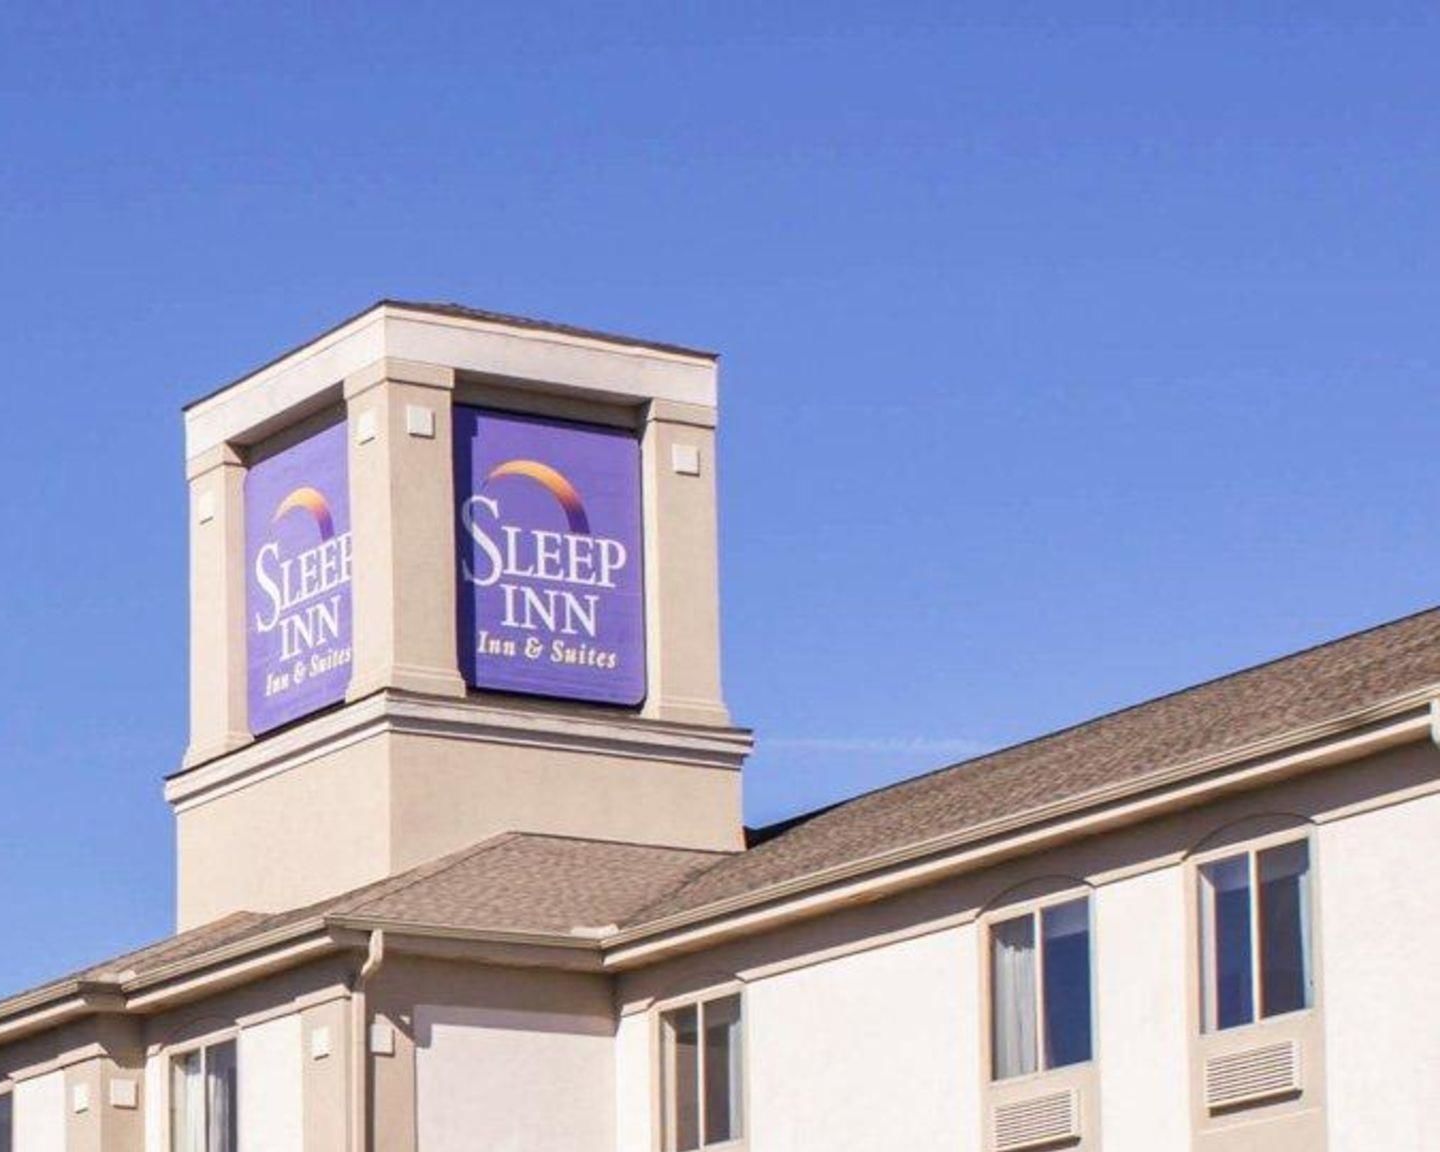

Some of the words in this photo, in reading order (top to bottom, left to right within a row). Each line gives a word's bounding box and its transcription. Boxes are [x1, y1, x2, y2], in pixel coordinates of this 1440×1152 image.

[462, 494, 627, 588] SLEEP
[279, 594, 342, 663] INN
[499, 583, 601, 637] INN
[477, 630, 516, 657] Inn
[524, 636, 544, 659] &
[550, 639, 617, 669] Suites
[265, 673, 290, 697] Inn
[293, 660, 306, 685] &
